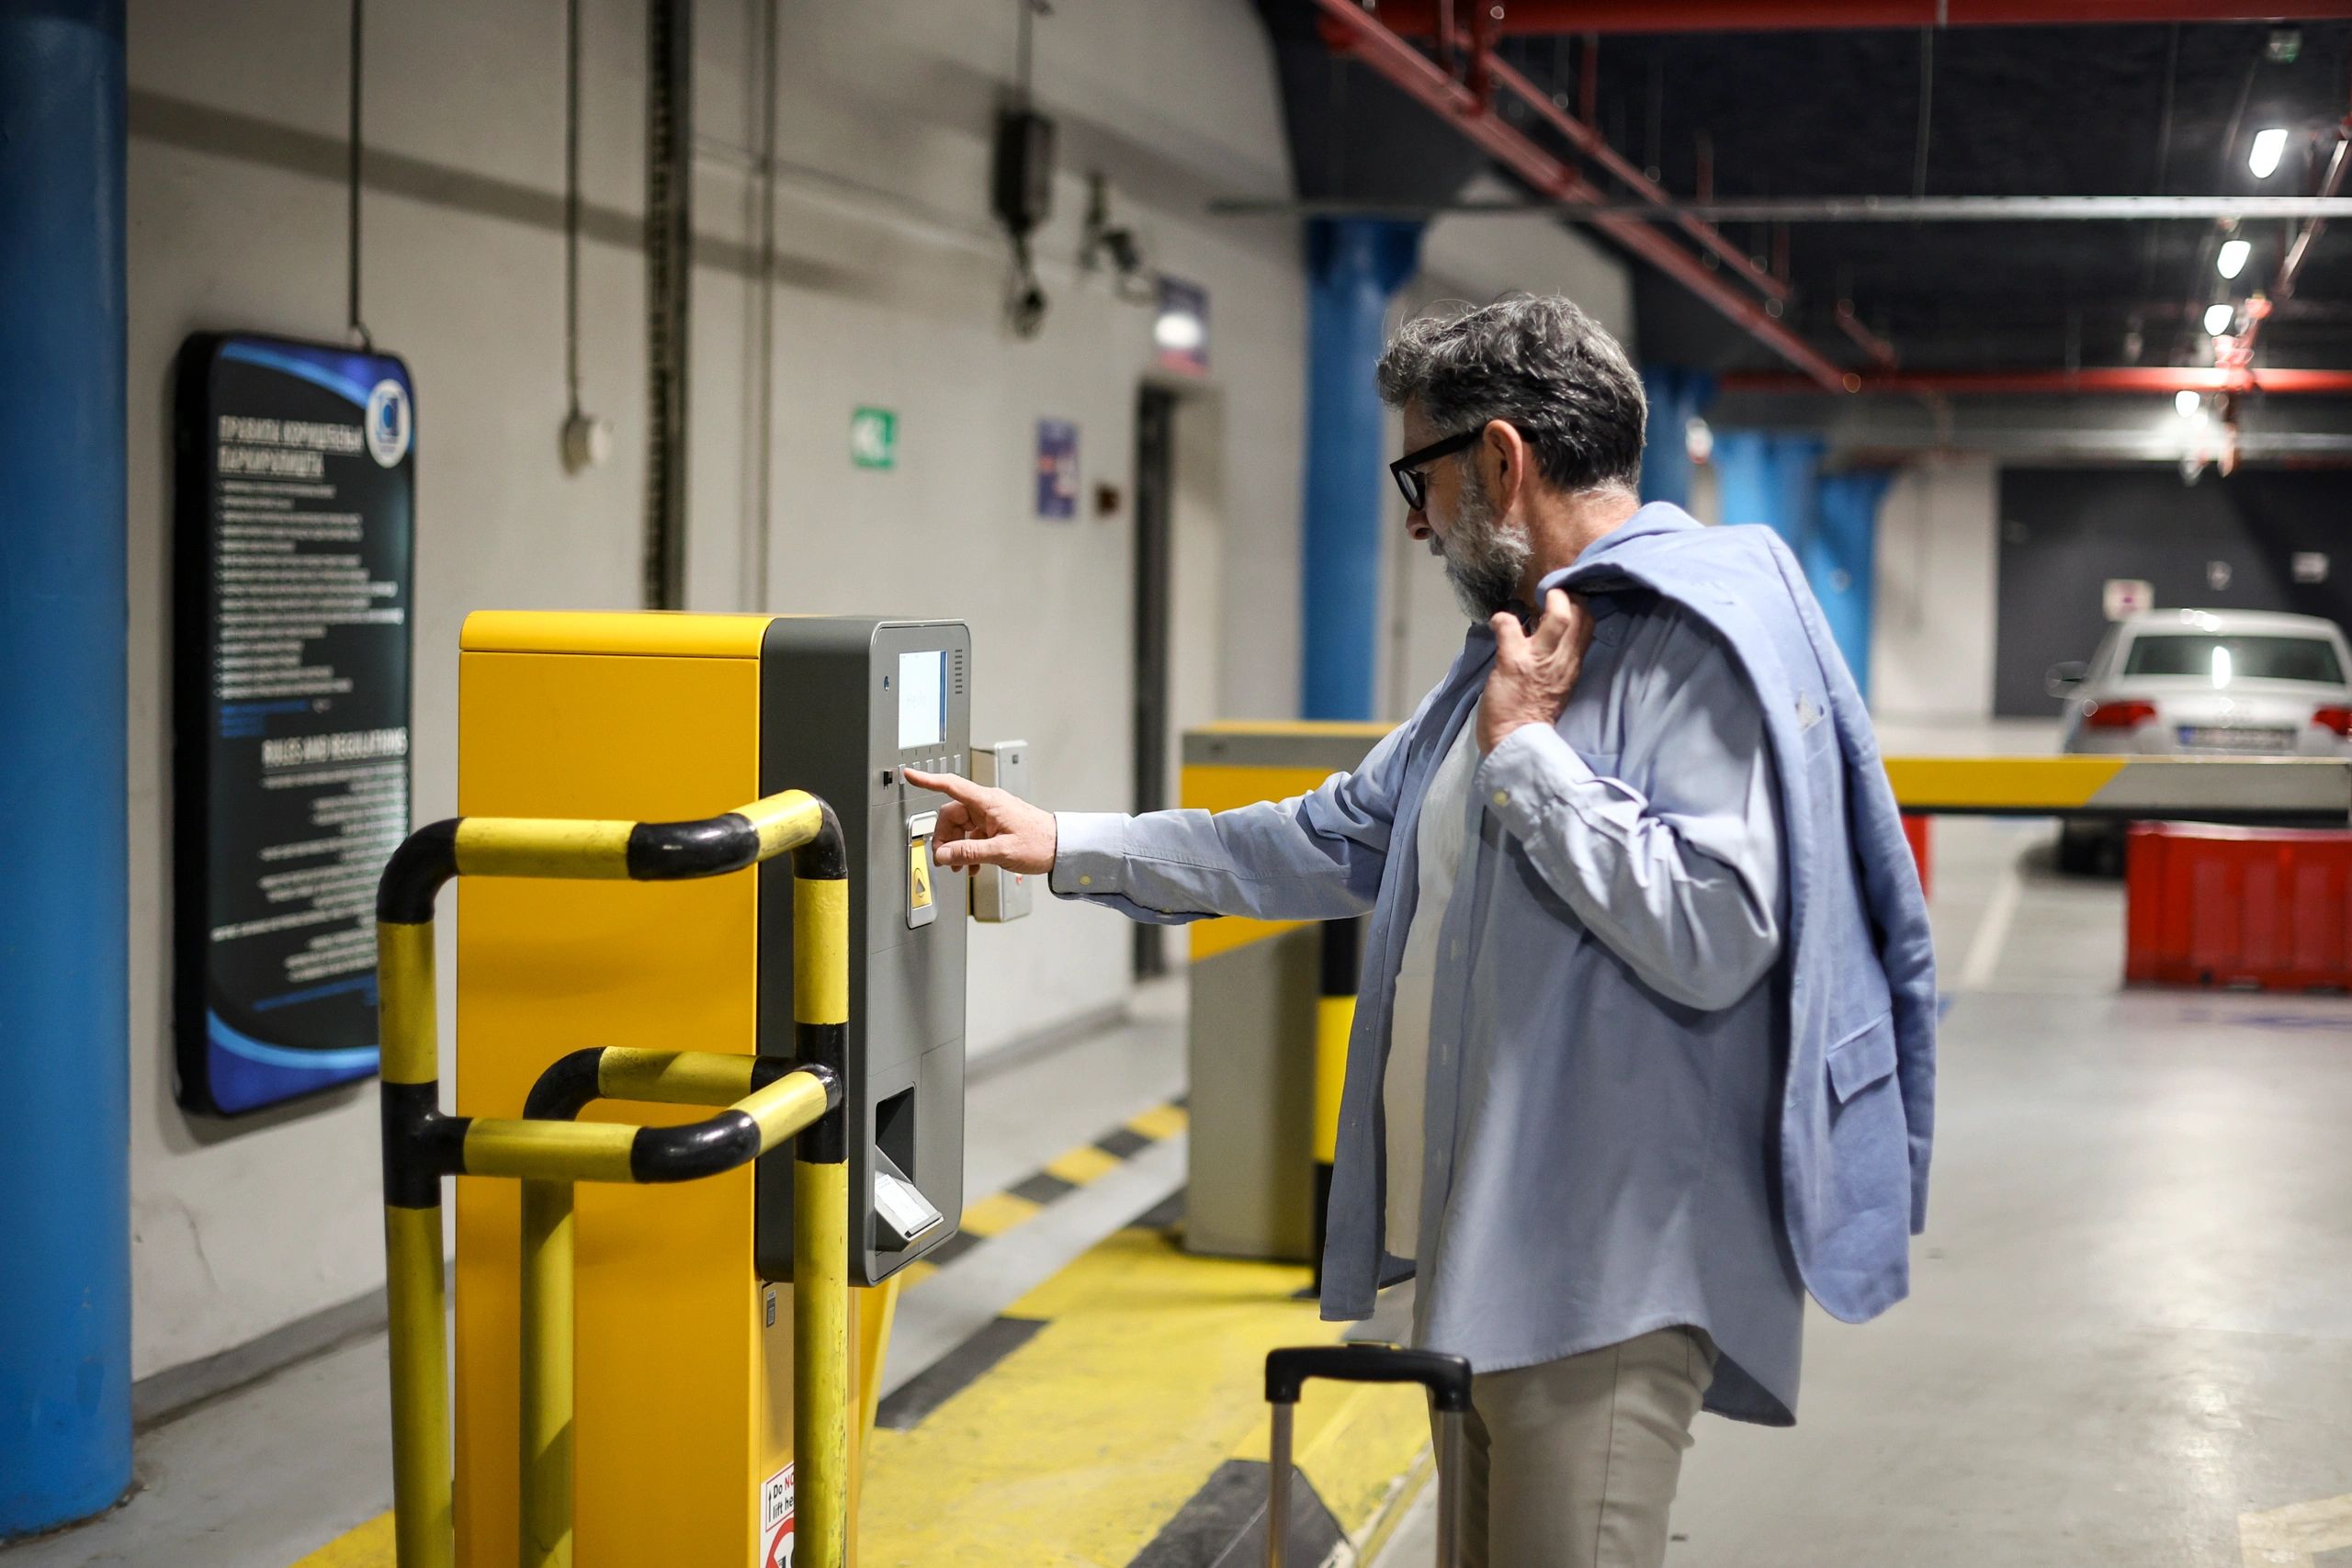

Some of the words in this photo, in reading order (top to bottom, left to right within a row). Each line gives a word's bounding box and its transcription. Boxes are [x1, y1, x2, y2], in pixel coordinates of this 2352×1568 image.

[262, 738, 304, 766] RULES
[304, 733, 330, 761] AND
[331, 727, 409, 760] REGULATIONS
[774, 1483, 783, 1499] Do
[785, 1472, 794, 1491] NO
[773, 1501, 783, 1520] lift
[785, 1496, 794, 1511] he
